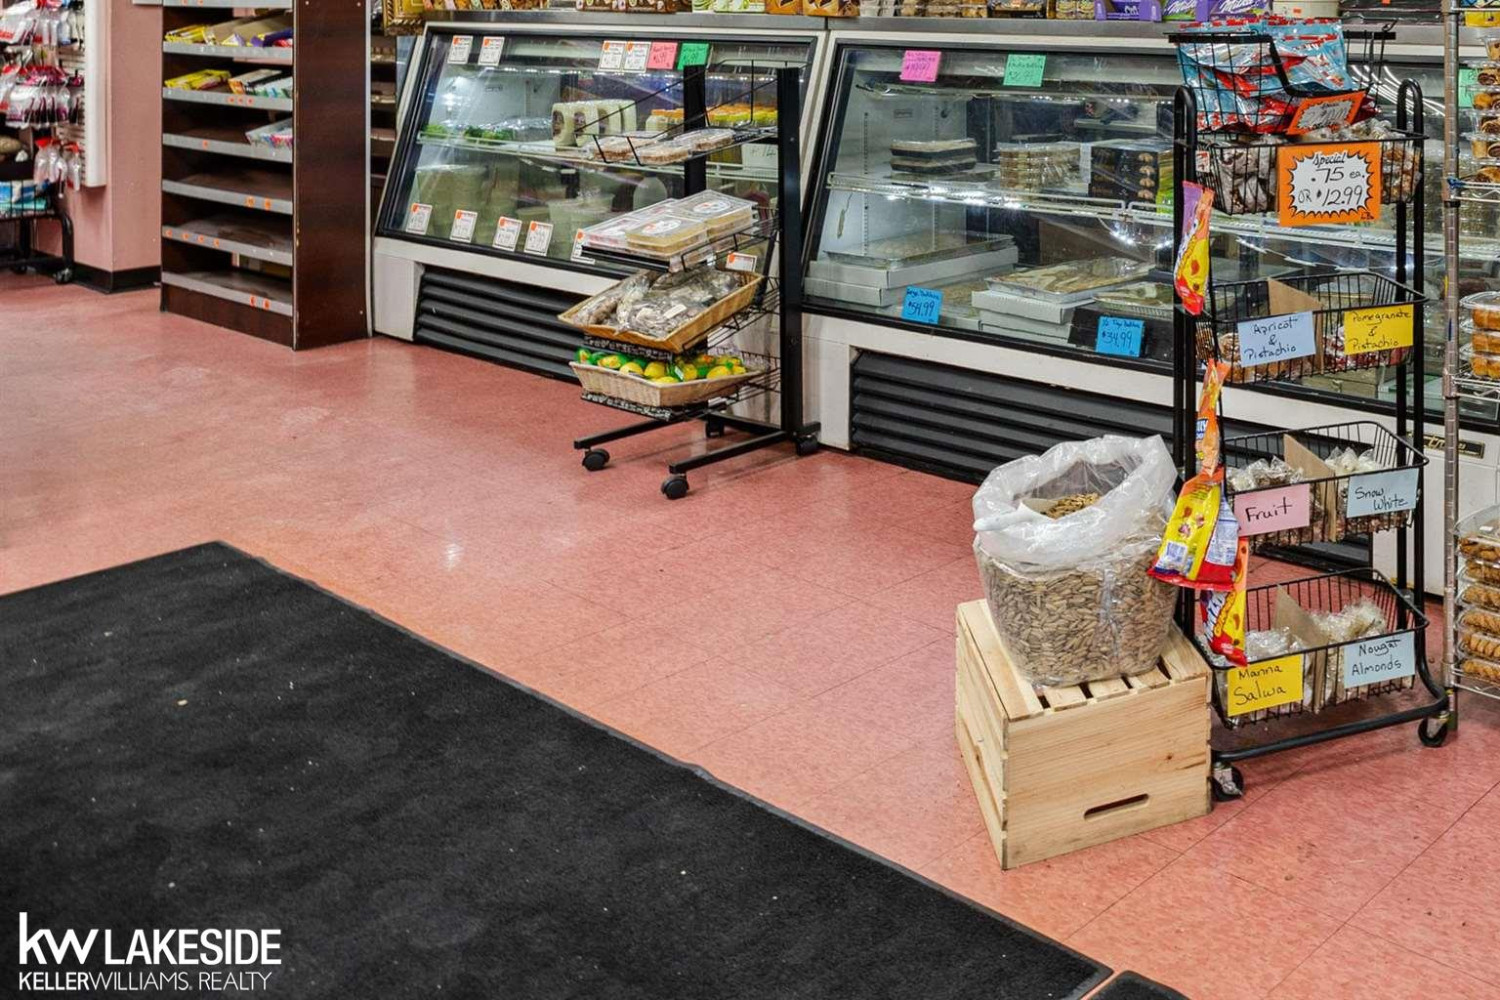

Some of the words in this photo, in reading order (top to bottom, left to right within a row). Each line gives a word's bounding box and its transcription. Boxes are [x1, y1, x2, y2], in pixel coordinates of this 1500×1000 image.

[1312, 152, 1346, 168] Special
[1298, 188, 1312, 204] OR
[1252, 316, 1299, 336] Apricot
[1352, 311, 1411, 326] Pomegranate
[1244, 342, 1297, 359] Pistachio
[1350, 336, 1399, 349] Pistachio
[1354, 486, 1385, 500] Snow
[1245, 497, 1293, 523] Fruit
[1372, 495, 1408, 511] White
[1358, 639, 1401, 657] Nougat
[1238, 664, 1283, 680] Manna
[1351, 658, 1403, 676] Almonds
[1233, 680, 1287, 706] Salwa
